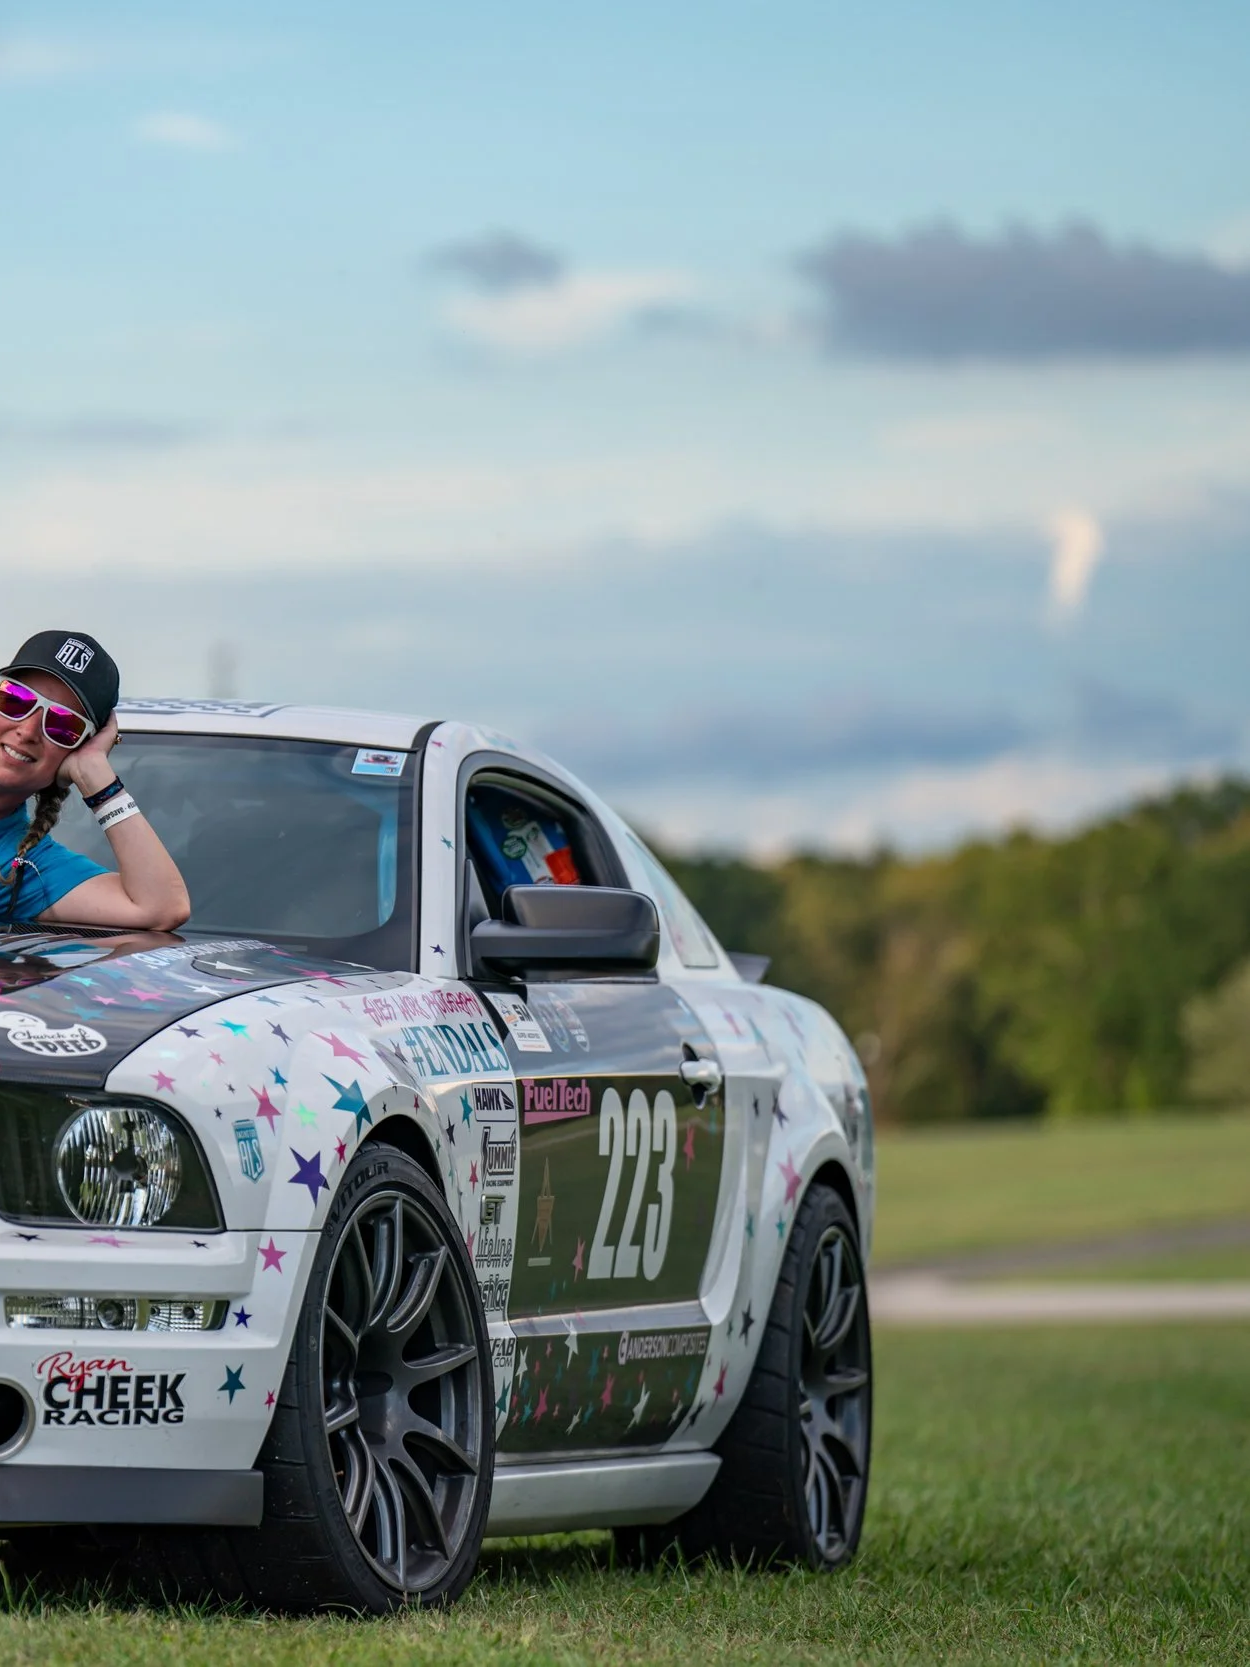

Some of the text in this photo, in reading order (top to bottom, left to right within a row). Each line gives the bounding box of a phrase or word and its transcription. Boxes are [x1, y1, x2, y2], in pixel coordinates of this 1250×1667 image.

[58, 644, 89, 670] ALS
[391, 993, 430, 1022] WORK
[12, 1030, 67, 1041] Church
[401, 1021, 510, 1077] #ENDALS
[474, 1088, 502, 1111] HAWK
[521, 1079, 591, 1114] FuelTech
[238, 1139, 263, 1180] ALS
[481, 1126, 516, 1188] SUMMIT
[331, 1161, 389, 1220] VITOUR
[587, 1087, 677, 1281] 223
[480, 1194, 506, 1225] GT
[489, 1337, 516, 1356] FAB
[37, 1351, 133, 1392] Ryan
[43, 1373, 187, 1410] CHEEK
[43, 1408, 184, 1426] RACING
